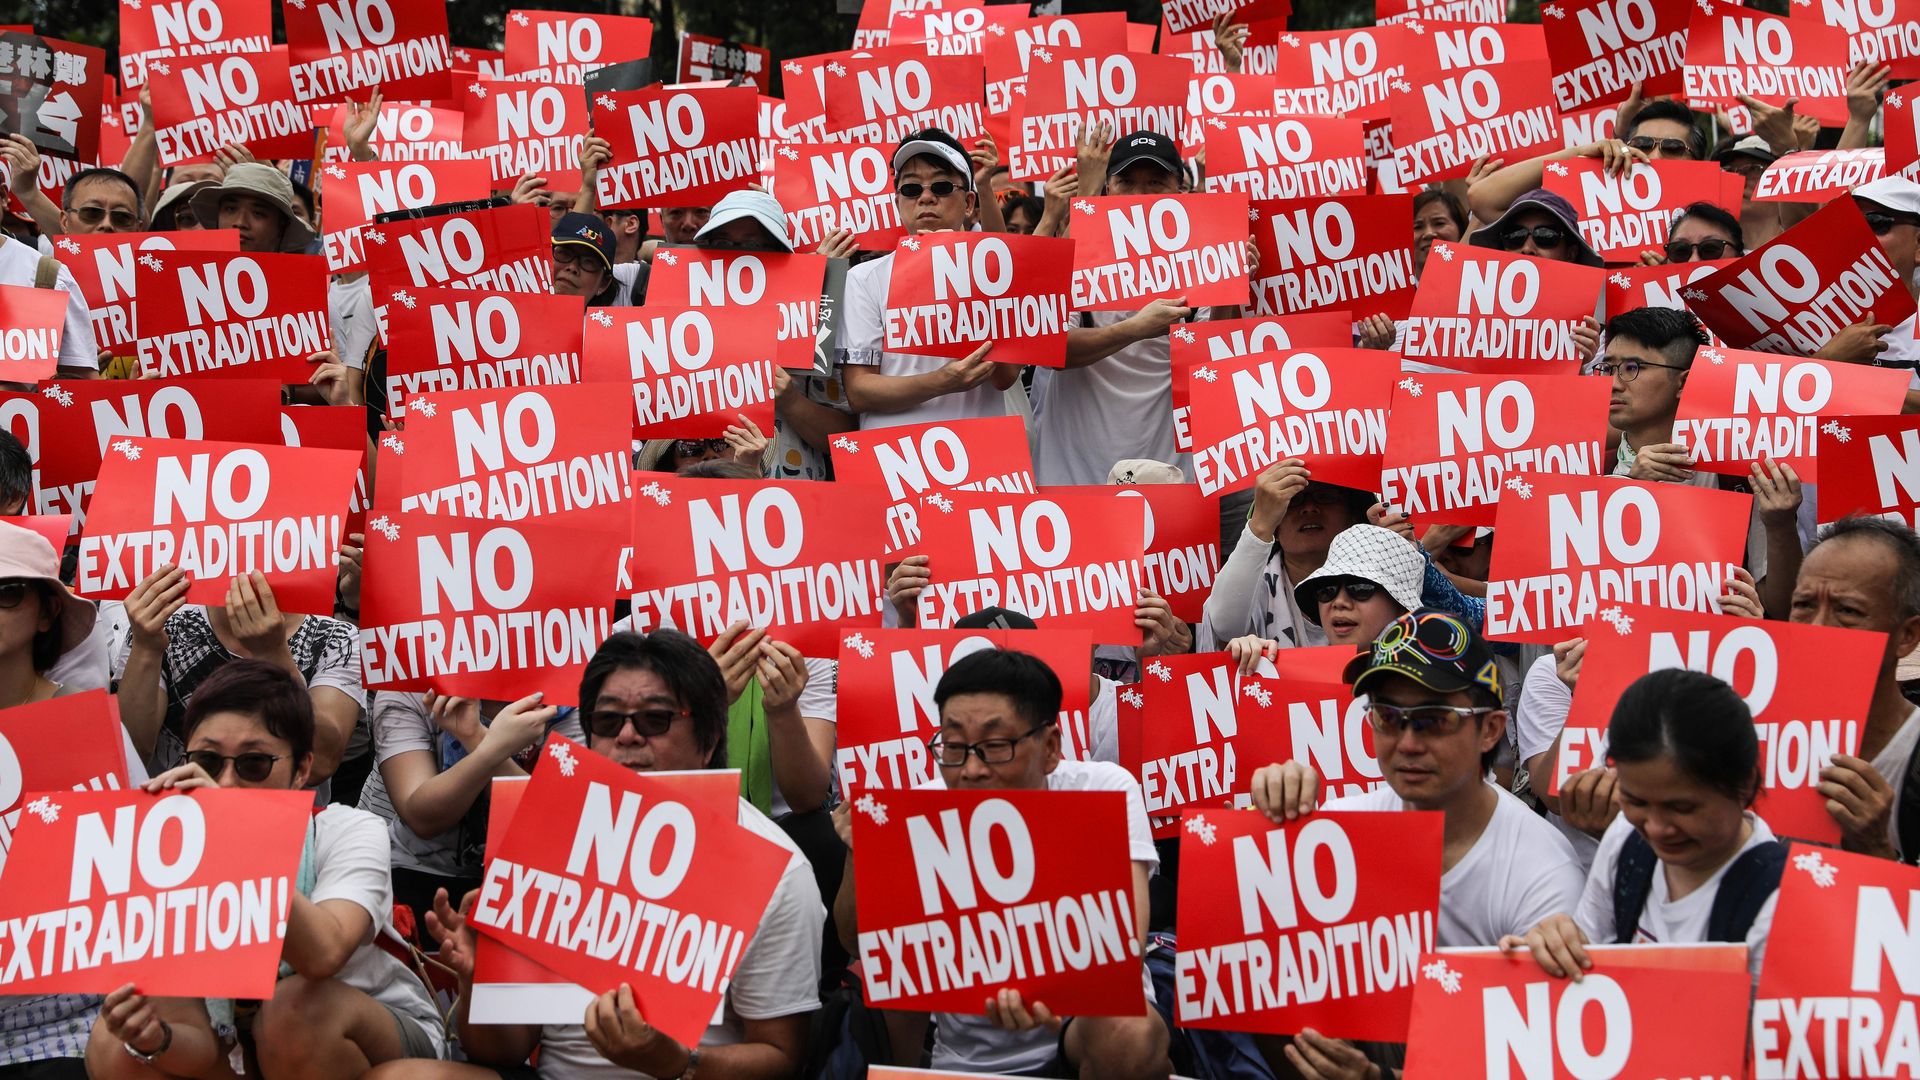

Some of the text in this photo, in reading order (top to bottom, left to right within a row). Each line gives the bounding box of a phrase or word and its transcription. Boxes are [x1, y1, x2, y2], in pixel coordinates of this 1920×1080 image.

[150, 0, 224, 47] NO
[317, 0, 396, 54] NO
[537, 17, 602, 66] NO
[924, 8, 985, 39] NO
[1435, 27, 1504, 70] NO
[1577, 0, 1657, 59] NO
[1723, 16, 1793, 66] NO
[181, 56, 260, 116] NO
[290, 34, 453, 102] EXTRADITION!
[857, 60, 931, 121] NO
[1063, 54, 1136, 109] NO
[1310, 31, 1377, 86] NO
[1553, 28, 1689, 112] EXTRADITIO
[1683, 65, 1847, 97] EXTRADITION!
[156, 99, 314, 164] EXTRADITION!
[368, 109, 434, 142] NO
[496, 86, 565, 142] NO
[627, 93, 705, 158] NO
[1022, 105, 1183, 152] EXTRADITION!
[1423, 69, 1500, 132] NO
[598, 137, 760, 208] EXTRADITION!
[810, 146, 888, 203] NO
[1131, 138, 1157, 147] EOS
[1238, 120, 1313, 169] NO
[1395, 106, 1557, 184] EXTRADITION!
[357, 163, 436, 221] NO
[1581, 163, 1662, 217] NO
[399, 218, 484, 287] NO
[1107, 198, 1190, 259] NO
[1271, 201, 1355, 270] NO
[94, 236, 176, 303] N
[177, 257, 269, 326] NO
[689, 256, 767, 306] NO
[931, 237, 1013, 301] NO
[1072, 241, 1249, 308] EXTRADITION!
[1458, 259, 1540, 317] NO
[1719, 244, 1819, 335] NO
[137, 310, 331, 378] EXTRADITION!
[430, 296, 520, 365] NO
[626, 310, 713, 380] NO
[886, 294, 1069, 349] EXTRADITION!
[632, 359, 776, 425] RADITION!
[1231, 352, 1332, 428] NO
[1437, 380, 1535, 458] NO
[1733, 362, 1833, 415] NO
[91, 386, 203, 462] NO
[452, 392, 556, 477] NO
[1193, 408, 1391, 498] EXTRADITION
[1672, 415, 1817, 463] EXTRADIT
[153, 448, 270, 526] NO
[873, 426, 970, 501] NO
[1868, 428, 1920, 508] N
[80, 514, 340, 594] EXTRADITION!
[688, 487, 804, 577] NO
[969, 500, 1072, 575] NO
[1548, 486, 1660, 569] NO
[417, 527, 534, 616] NO
[631, 559, 883, 640] EXTRADITION!
[359, 606, 609, 685] EXTRADITION!
[69, 794, 206, 903] NO
[565, 781, 697, 900] NO
[906, 798, 1036, 916] NO
[1233, 818, 1358, 935] NO
[473, 857, 745, 994] EXTRADITION!
[857, 889, 1141, 1003] EXTRADITION!
[1849, 885, 1920, 994] N
[1482, 974, 1633, 1080] NO
